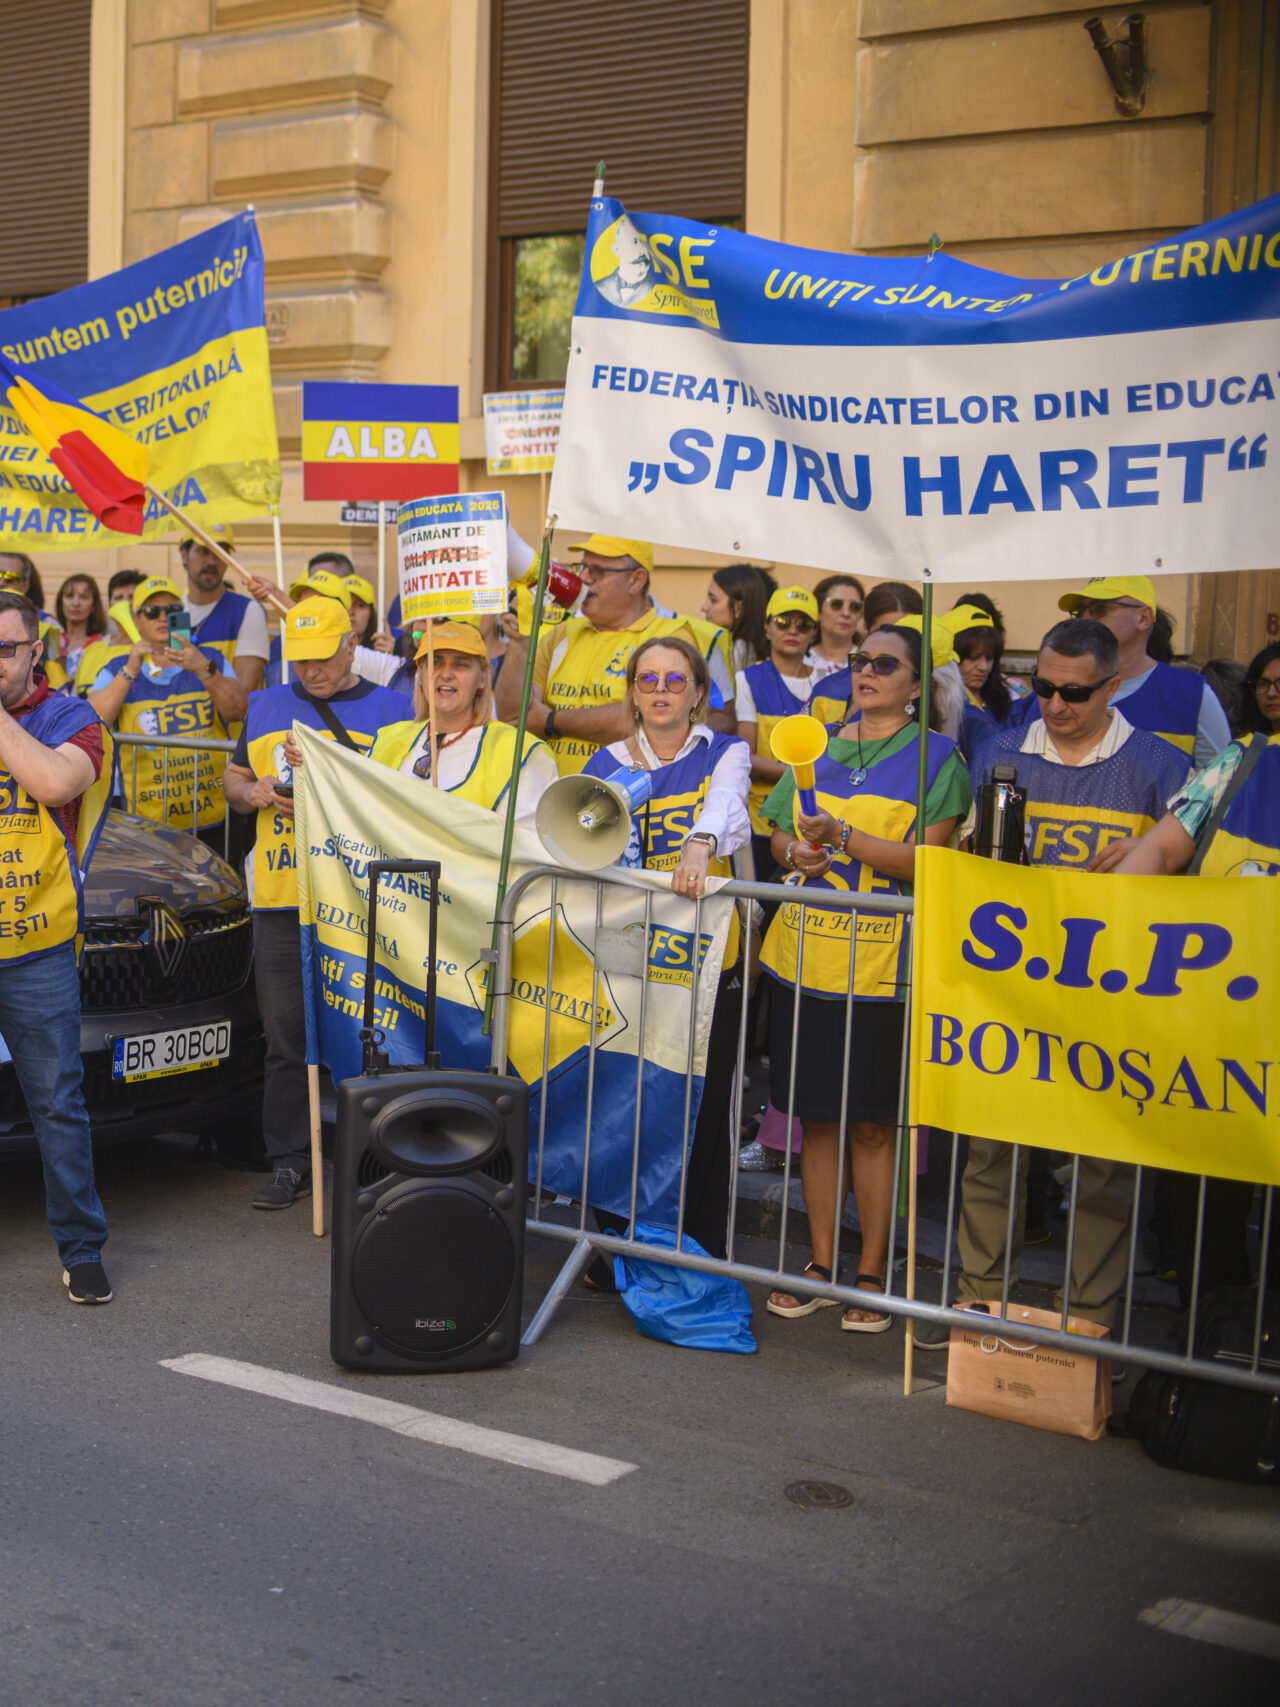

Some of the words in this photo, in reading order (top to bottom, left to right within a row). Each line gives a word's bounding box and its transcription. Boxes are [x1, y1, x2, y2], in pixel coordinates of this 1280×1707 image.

[764, 268, 875, 308] UNIȚI
[1, 315, 111, 365] suntem
[116, 246, 249, 340] puternici!
[592, 364, 765, 414] FEDERAȚIA
[764, 390, 1020, 425] SINDICATELOR
[1034, 387, 1109, 421] DIN
[1127, 371, 1280, 413] EDUCA
[325, 425, 438, 459] ALBA
[470, 500, 500, 512] 2025
[466, 525, 487, 537] DE
[404, 570, 488, 595] CANTITATE
[157, 699, 213, 734] FSE
[14, 895, 26, 913] 5
[961, 901, 1259, 1001] S.I.P.
[126, 1038, 156, 1071] BR
[163, 1025, 229, 1064] 30BCD
[925, 1013, 1280, 1117] BOTOȘAN
[114, 1060, 124, 1072] RO
[415, 1318, 446, 1328] ibiza
